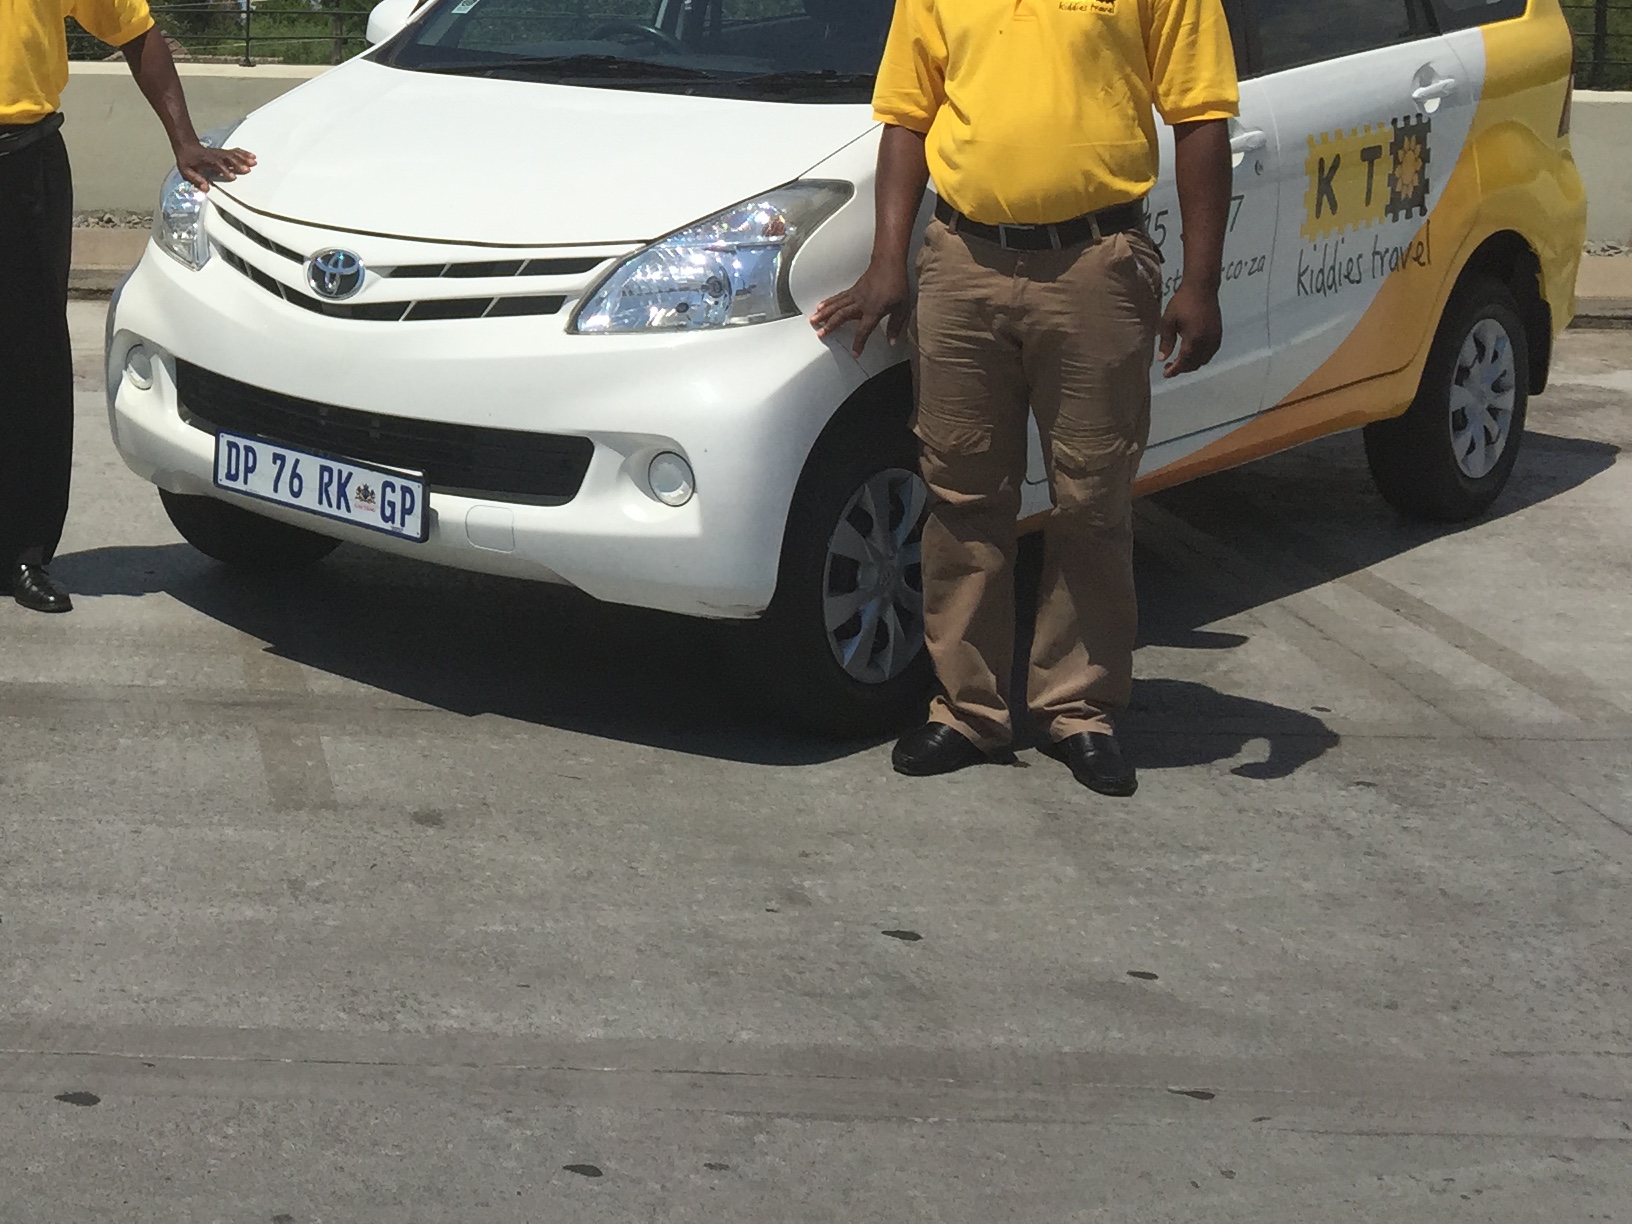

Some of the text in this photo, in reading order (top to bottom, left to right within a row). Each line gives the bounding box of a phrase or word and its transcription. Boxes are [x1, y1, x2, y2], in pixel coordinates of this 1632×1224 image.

[1296, 218, 1432, 297] kiddies travel
[224, 439, 416, 528] DP 76 RK GP
